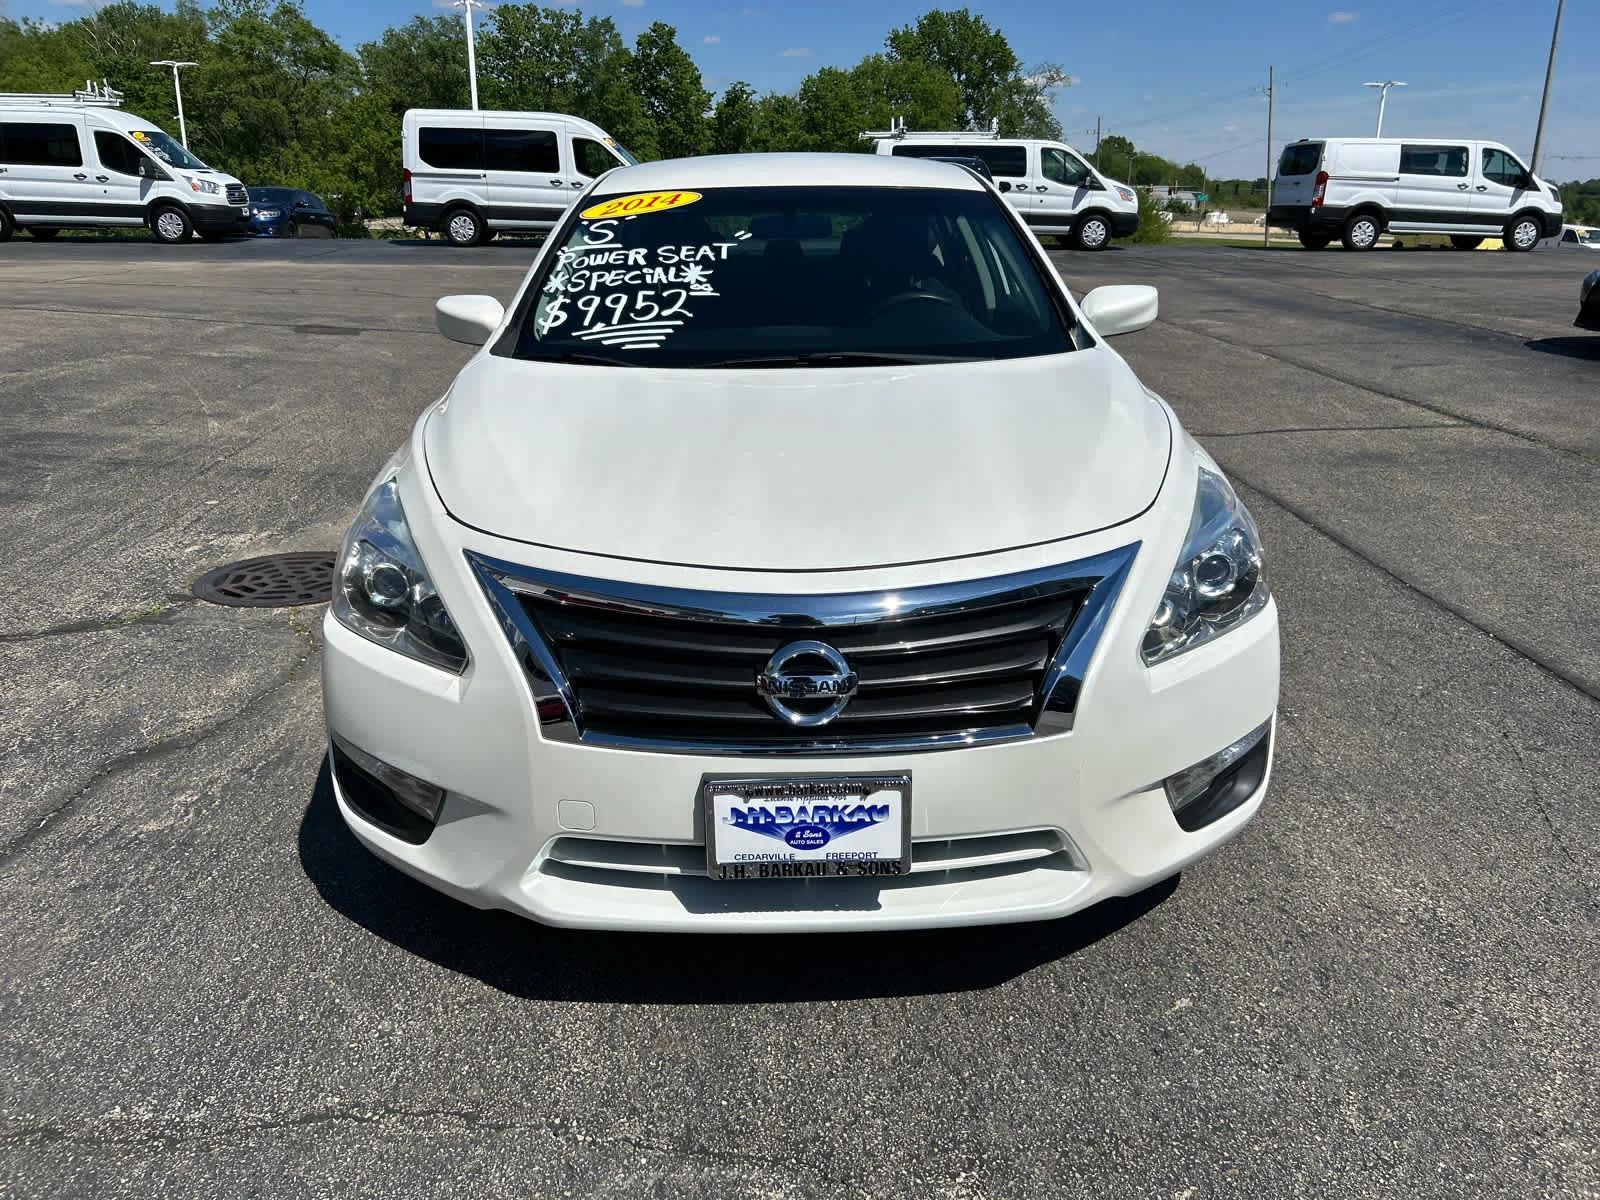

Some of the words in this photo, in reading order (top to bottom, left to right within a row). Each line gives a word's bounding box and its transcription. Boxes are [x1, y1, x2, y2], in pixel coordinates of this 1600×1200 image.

[602, 193, 682, 216] 2014
[768, 677, 849, 695] NISSAN
[733, 853, 795, 861] CEDARVILLE
[825, 851, 879, 860] FREEPORT
[759, 861, 827, 879] BARKAU
[836, 860, 849, 876] &
[857, 859, 901, 876] SONS
